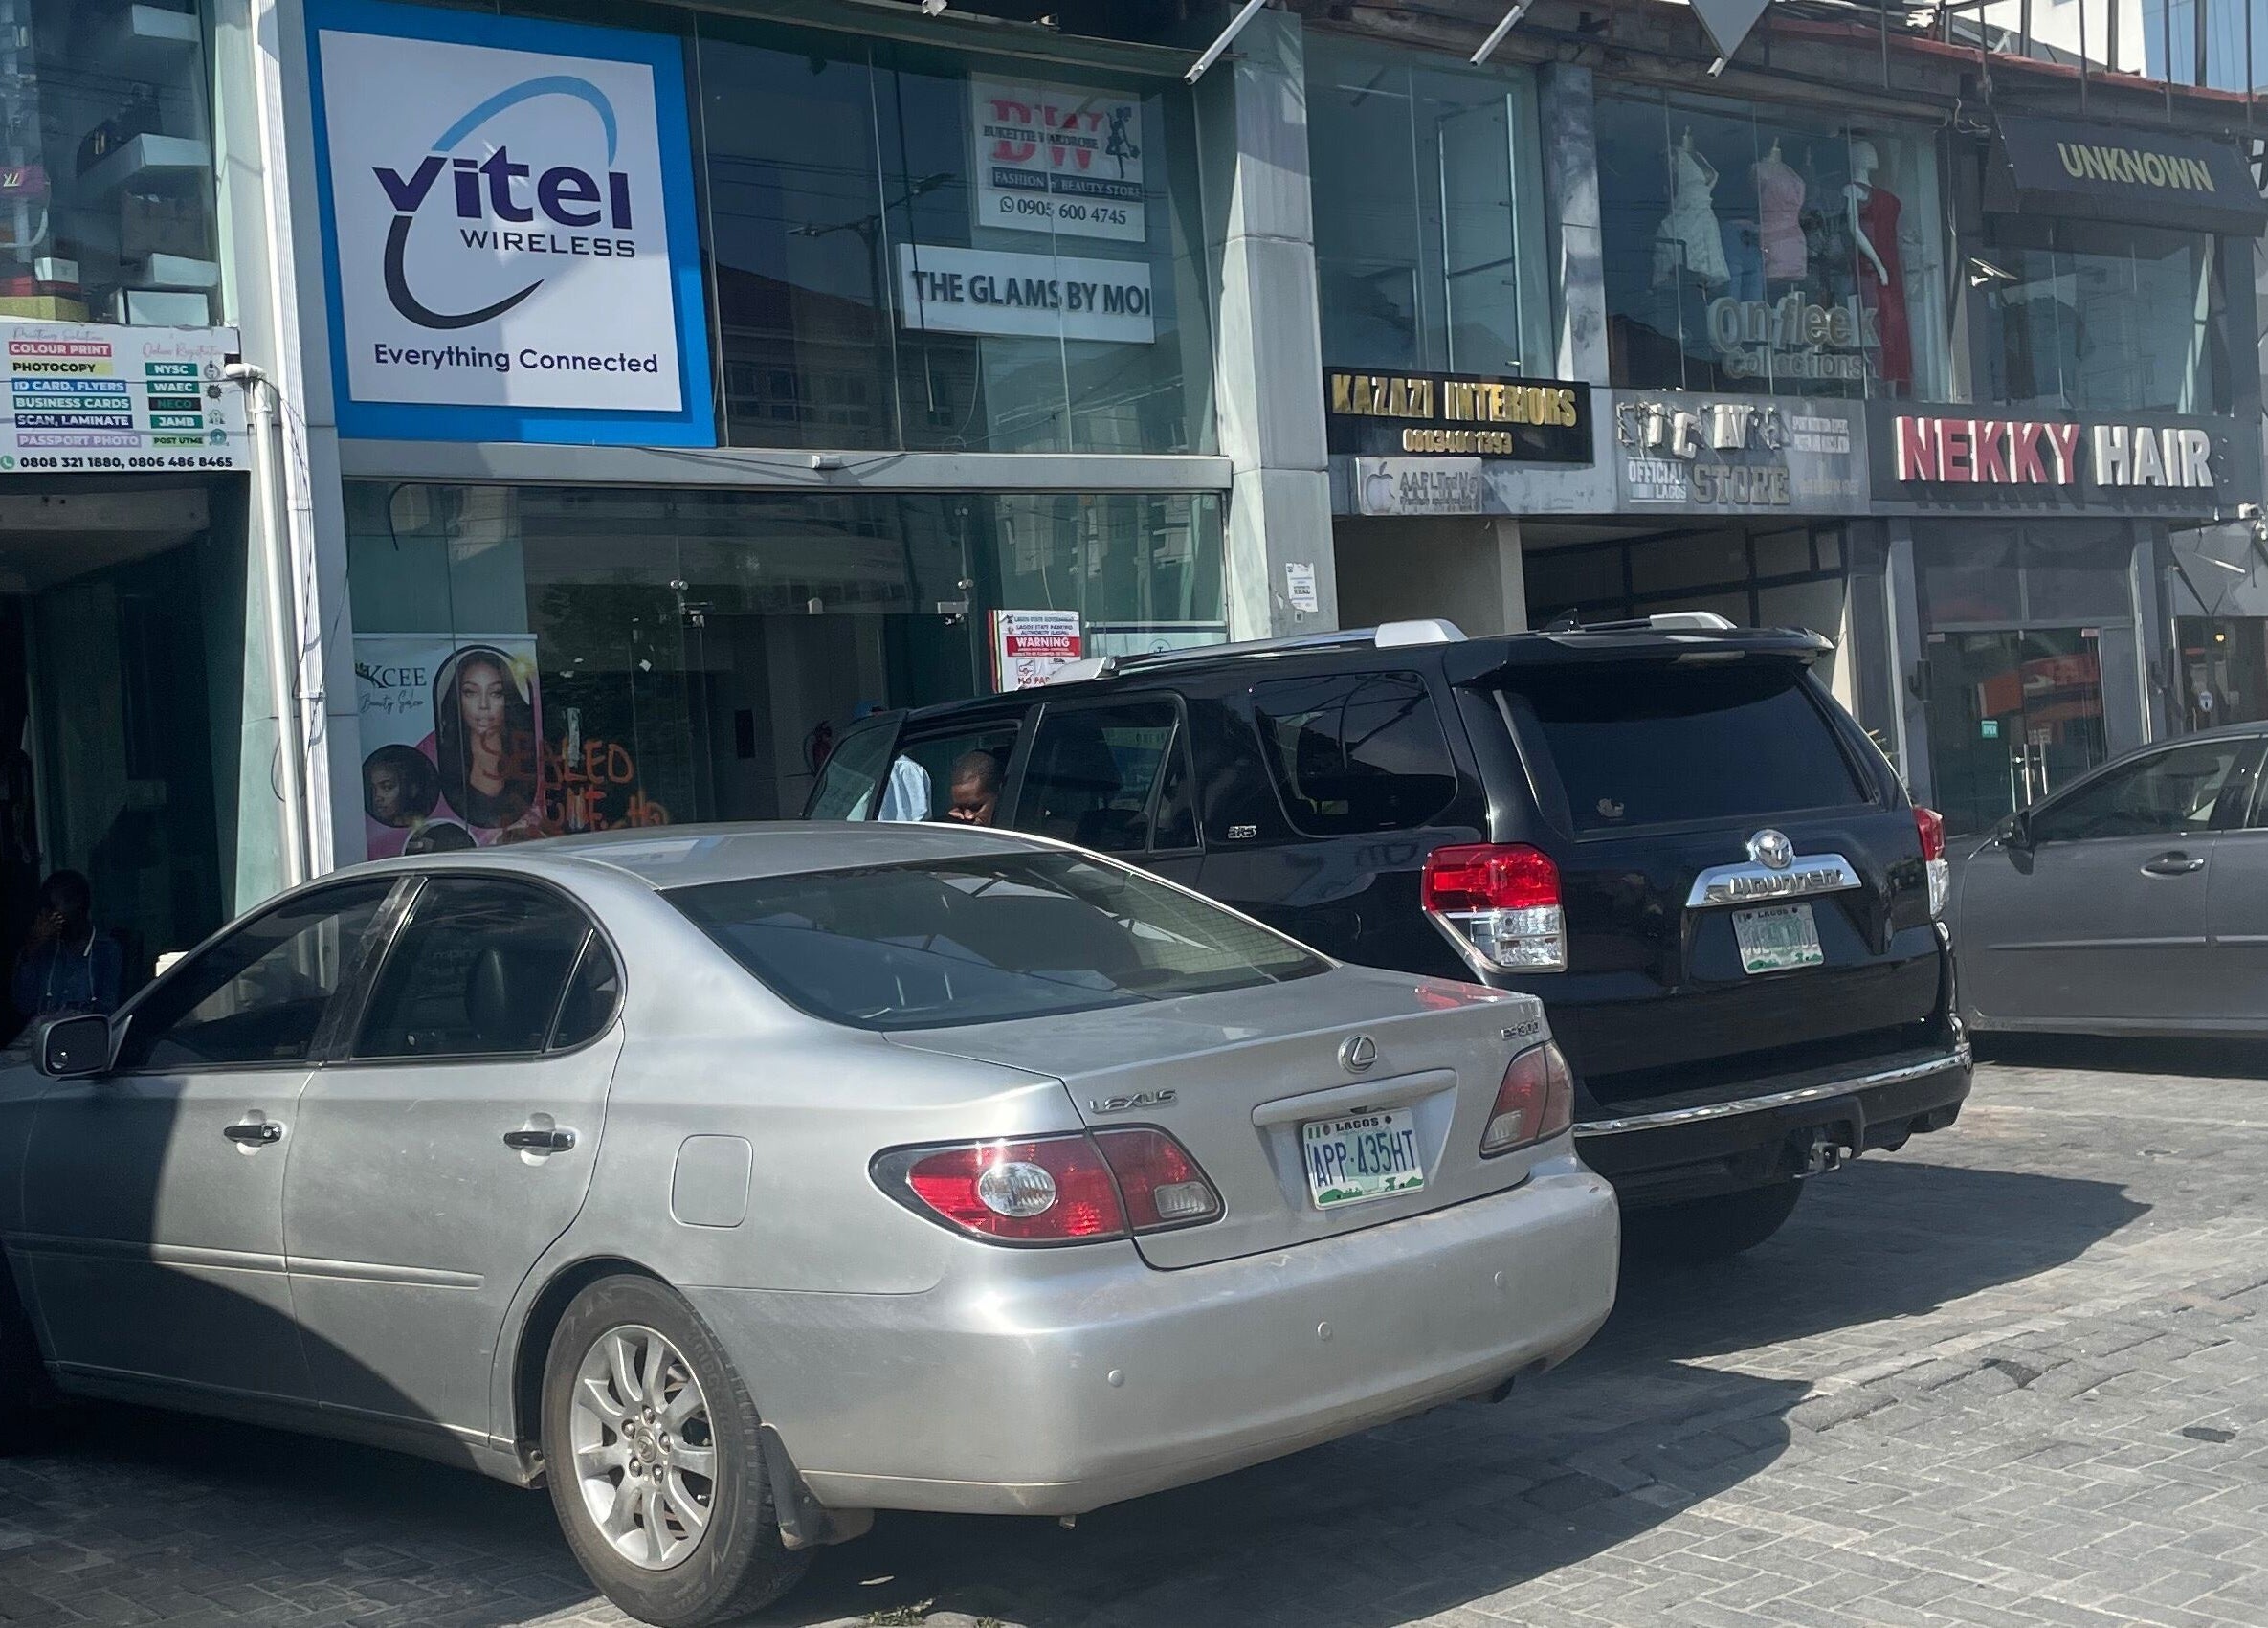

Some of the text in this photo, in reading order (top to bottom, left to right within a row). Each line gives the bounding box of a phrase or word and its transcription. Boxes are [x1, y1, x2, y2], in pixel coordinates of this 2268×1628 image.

[2057, 143, 2216, 191] UNKNOWN
[995, 172, 1045, 187] FASHION
[1061, 180, 1104, 193] BEAUTY
[1059, 204, 1086, 221] 600
[1091, 209, 1126, 225] 4745
[460, 229, 635, 258] WIRELESS
[912, 270, 964, 303] THE
[969, 275, 1062, 309] GLAMS
[1067, 281, 1097, 313] BY
[11, 344, 109, 355] COLOUR PRINT
[374, 344, 658, 374] Everything Connected
[12, 363, 96, 373] PHOTOCOPY
[154, 365, 189, 374] NYSC
[14, 381, 124, 391] ID CARD, FLYERS
[154, 383, 193, 391] WAEC
[15, 398, 129, 410] BUSINESS CARDS
[157, 399, 192, 409] NECO
[1331, 374, 1434, 419] KAZAZI
[16, 415, 129, 427] SCAN, LAMINATE
[158, 417, 195, 427] JAMB
[19, 435, 138, 446] PASSPORT PHOTO
[1896, 416, 2080, 486] NEKKY
[2094, 424, 2214, 488] HAIR
[20, 457, 57, 468] 0808
[62, 457, 83, 468] 321
[128, 457, 165, 467] 0806
[168, 457, 195, 467] 486
[1629, 461, 1686, 484] OFFICIAL
[1656, 484, 1687, 500] LAGOS
[1693, 464, 1791, 505] STORE
[1015, 636, 1070, 648] WARNING
[1089, 1089, 1177, 1114] LEXUS
[1335, 1117, 1379, 1132] LAGOS
